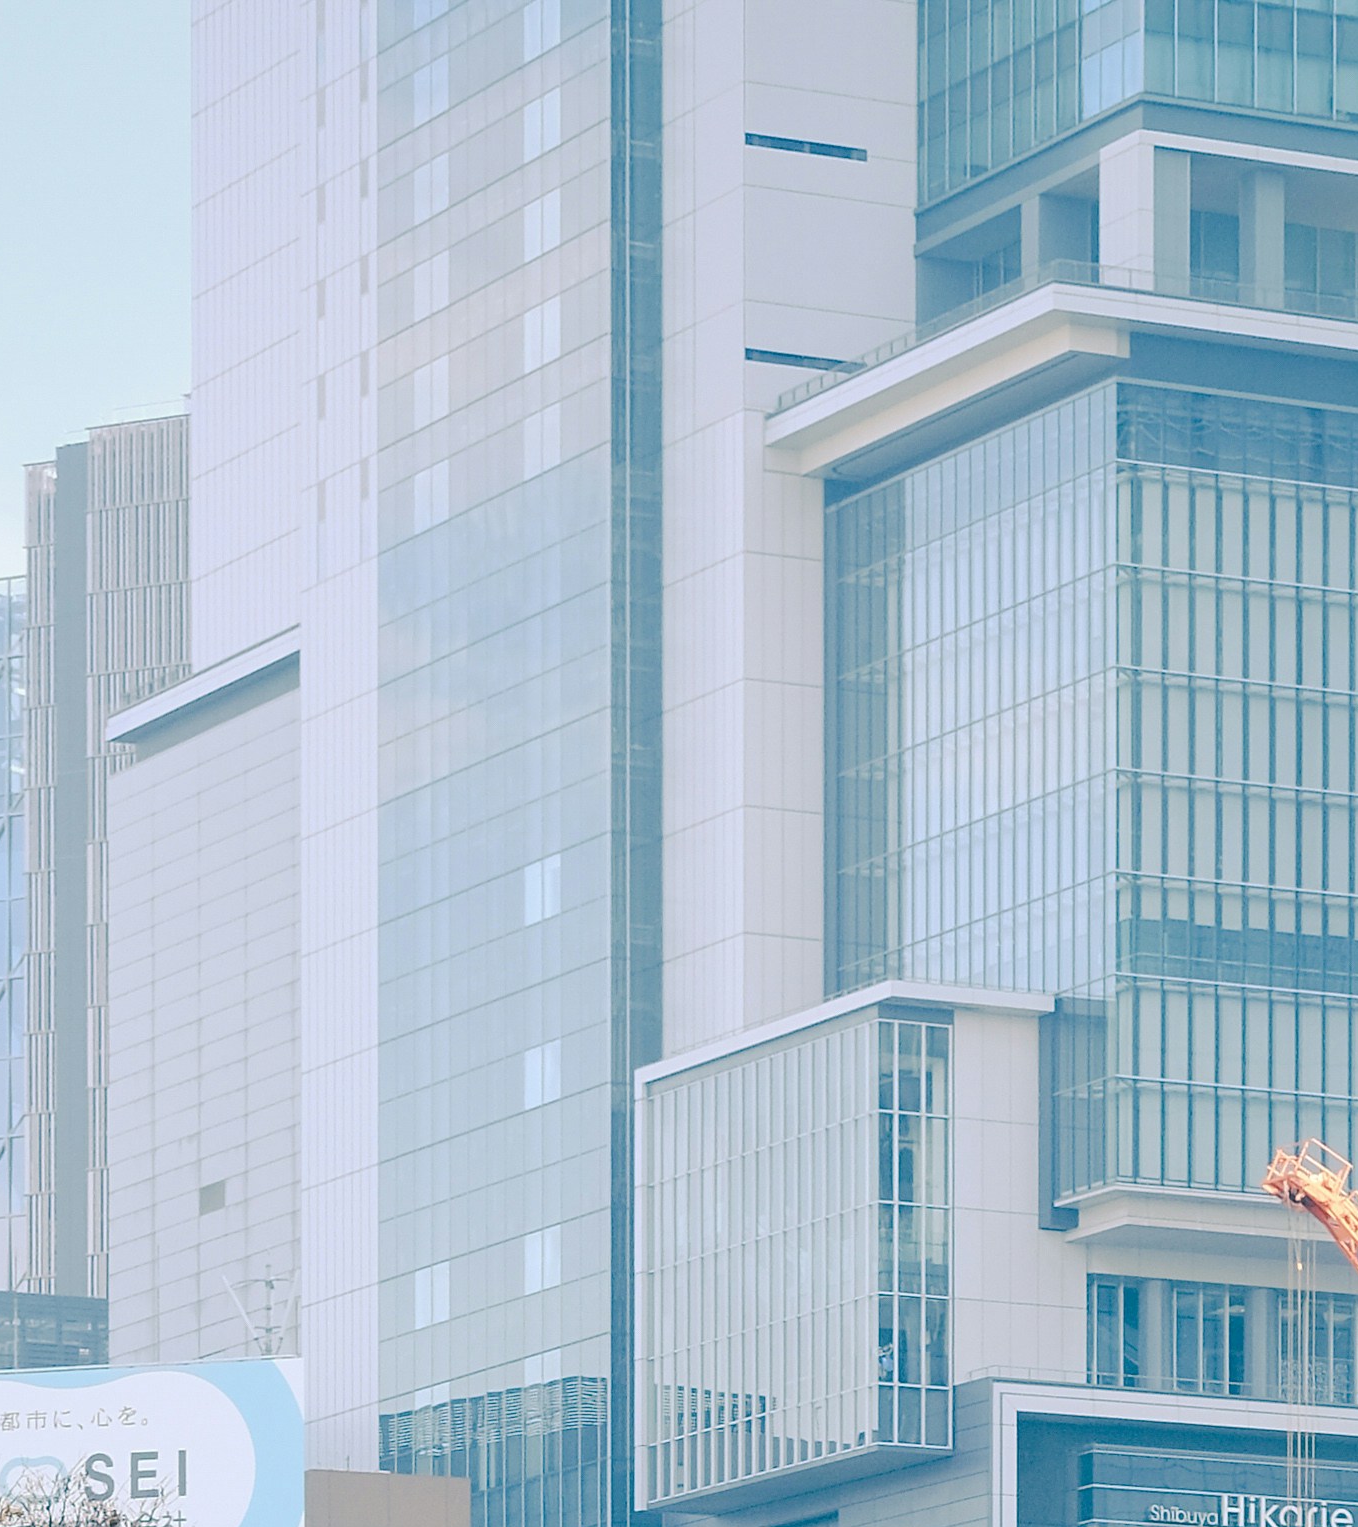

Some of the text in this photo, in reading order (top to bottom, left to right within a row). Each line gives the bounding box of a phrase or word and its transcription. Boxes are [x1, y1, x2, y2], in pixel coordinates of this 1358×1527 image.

[0, 1406, 151, 1432] 都市に、心を。
[1150, 1503, 1219, 1527] Shibuya
